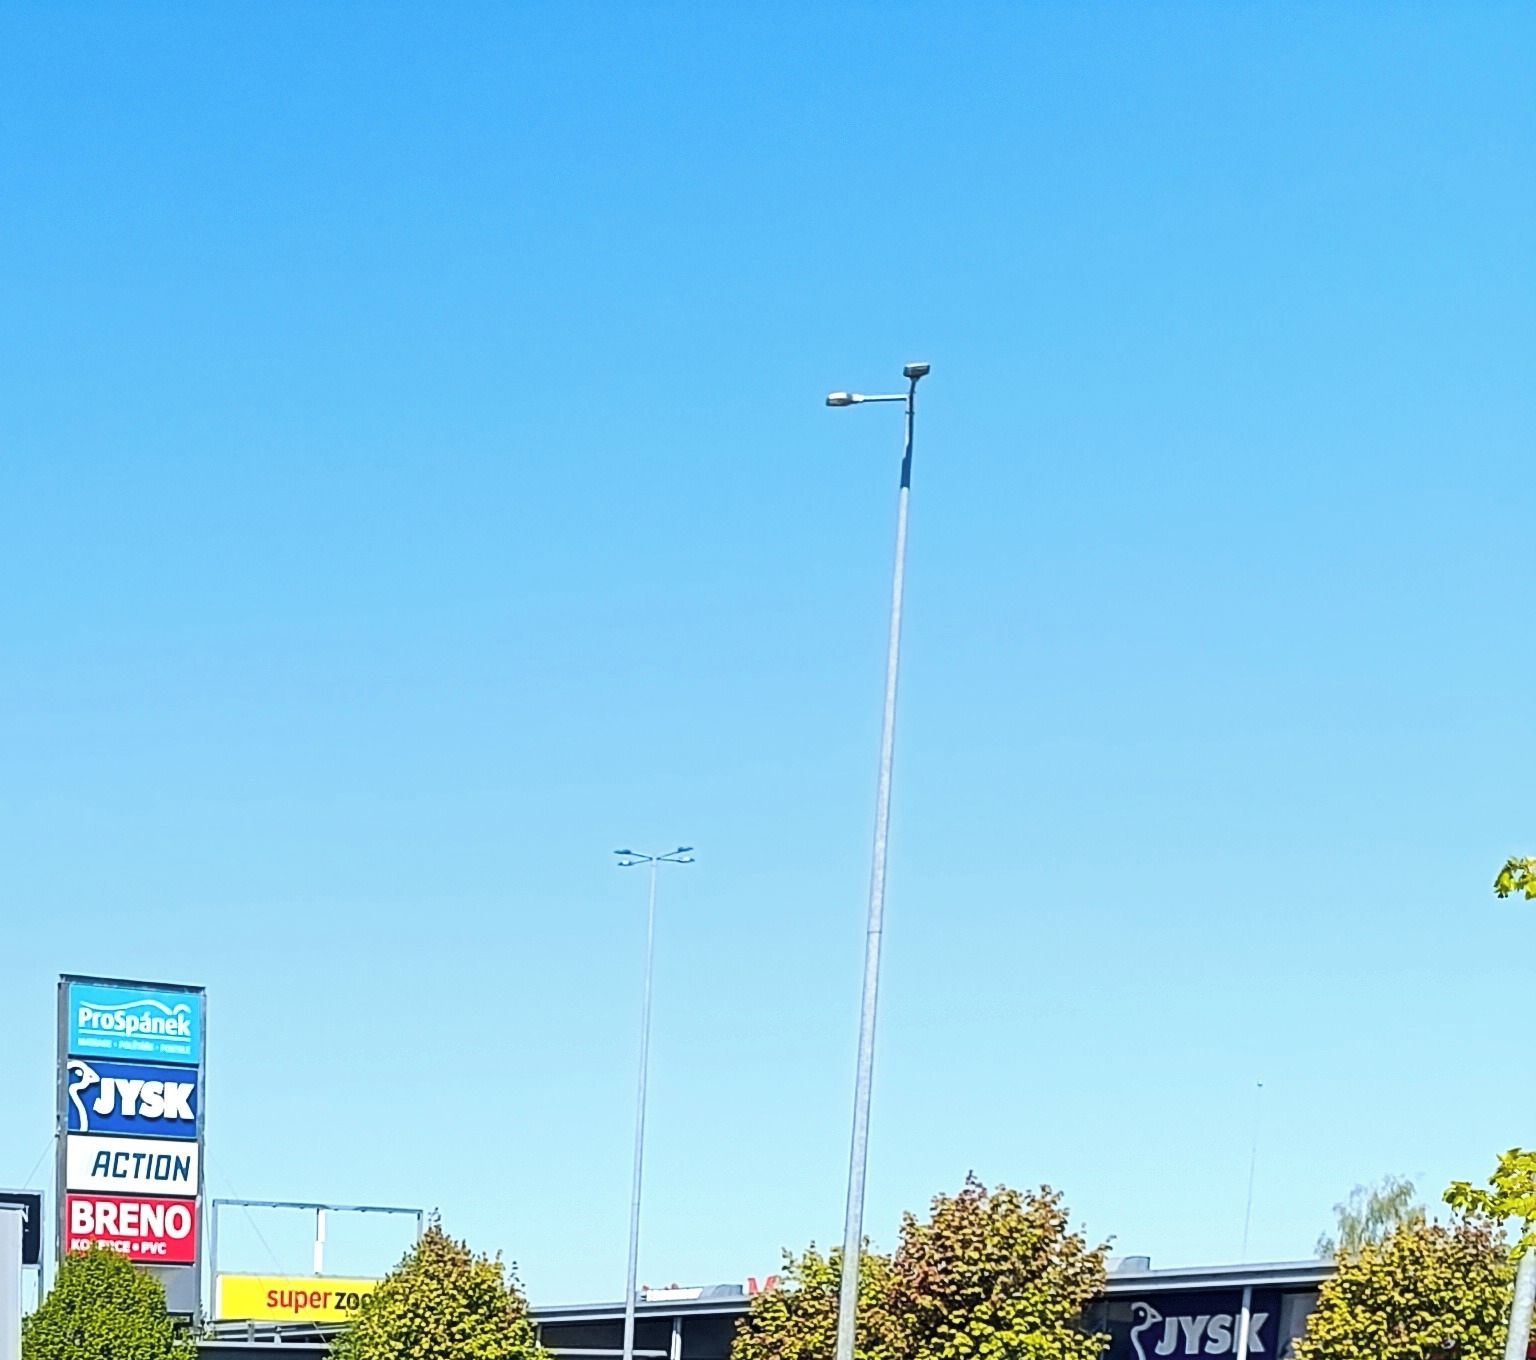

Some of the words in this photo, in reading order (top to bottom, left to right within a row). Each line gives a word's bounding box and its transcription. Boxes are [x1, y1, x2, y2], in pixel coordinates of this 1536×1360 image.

[78, 1008, 191, 1037] ProSpánek
[93, 1077, 195, 1120] JYSK
[91, 1150, 191, 1181] ACTION
[71, 1200, 191, 1239] BRENO
[71, 1239, 130, 1254] KOECE
[140, 1242, 166, 1255] PVC
[1154, 1313, 1269, 1355] JYSK
